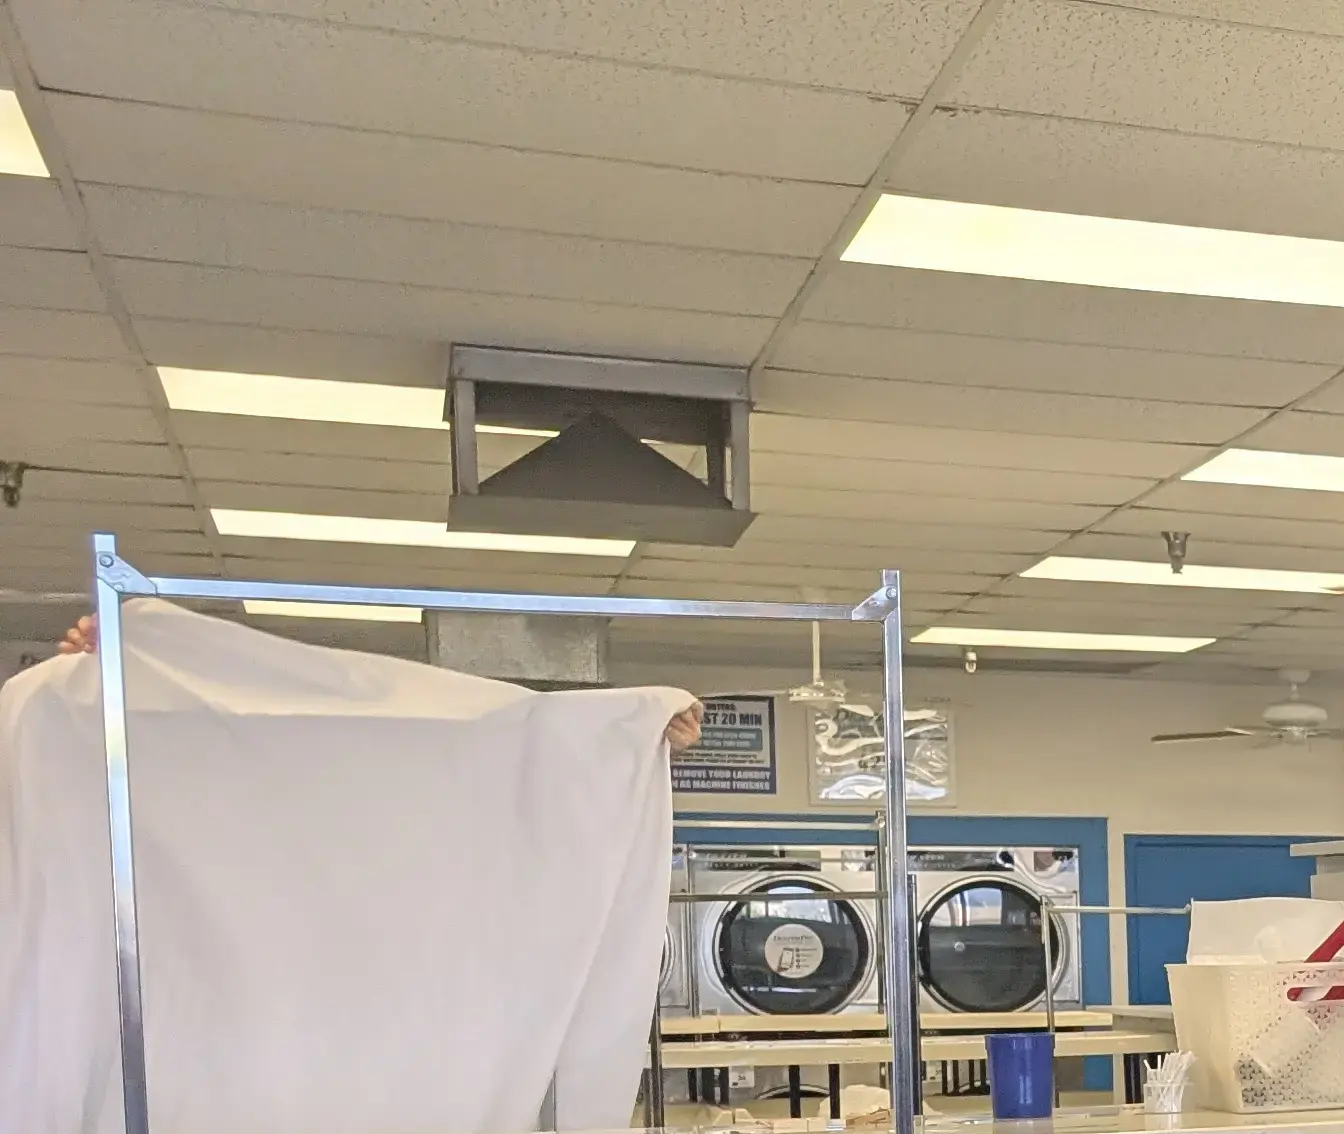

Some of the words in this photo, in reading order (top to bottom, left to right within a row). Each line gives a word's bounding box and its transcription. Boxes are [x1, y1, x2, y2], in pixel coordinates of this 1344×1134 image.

[721, 713, 737, 725] 20
[740, 713, 762, 725] MIN
[672, 768, 706, 778] REMOVE
[708, 769, 731, 779] YOUR
[732, 770, 770, 780] LAUNDRY
[693, 780, 731, 789] MACHINE
